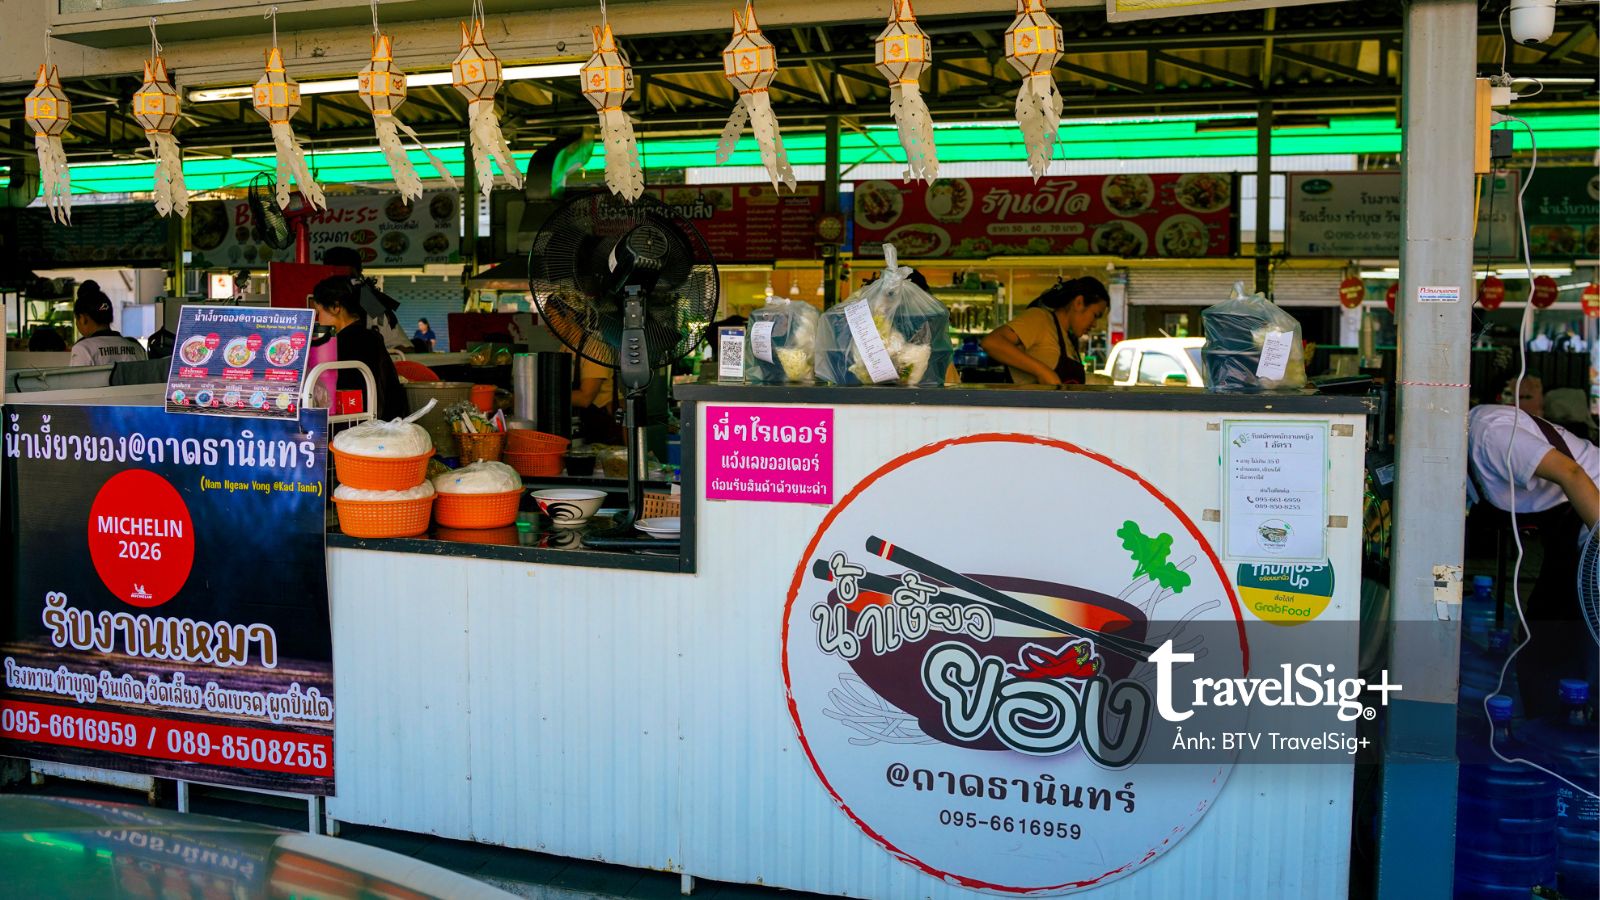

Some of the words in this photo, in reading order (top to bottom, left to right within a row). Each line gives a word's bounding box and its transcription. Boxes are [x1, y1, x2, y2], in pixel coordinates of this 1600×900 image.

[98, 346, 136, 357] THAILAND
[721, 450, 820, 471] แจ้งเลขออเดอร์
[225, 480, 249, 493] Ngeaw
[251, 480, 270, 494] Yong
[98, 515, 184, 538] MICHELIN
[118, 540, 162, 561] 2026
[1290, 570, 1310, 590] Up
[1254, 602, 1311, 617] GrabFood
[43, 591, 278, 669] รับงานเหมา
[4, 656, 52, 690] โรงทาน
[54, 666, 97, 702] ทำบุญ
[100, 670, 146, 703] วันเกิด
[147, 672, 200, 708] จัดเลี้ยง
[204, 681, 263, 713] จัดเบรค
[267, 682, 333, 723] ผูกปิ่นโต
[1, 708, 137, 747] 095-6616959
[167, 729, 327, 769] 089-8508255
[886, 761, 1136, 814] @กาดธานินทร์
[939, 809, 1082, 841] 095-6616959
